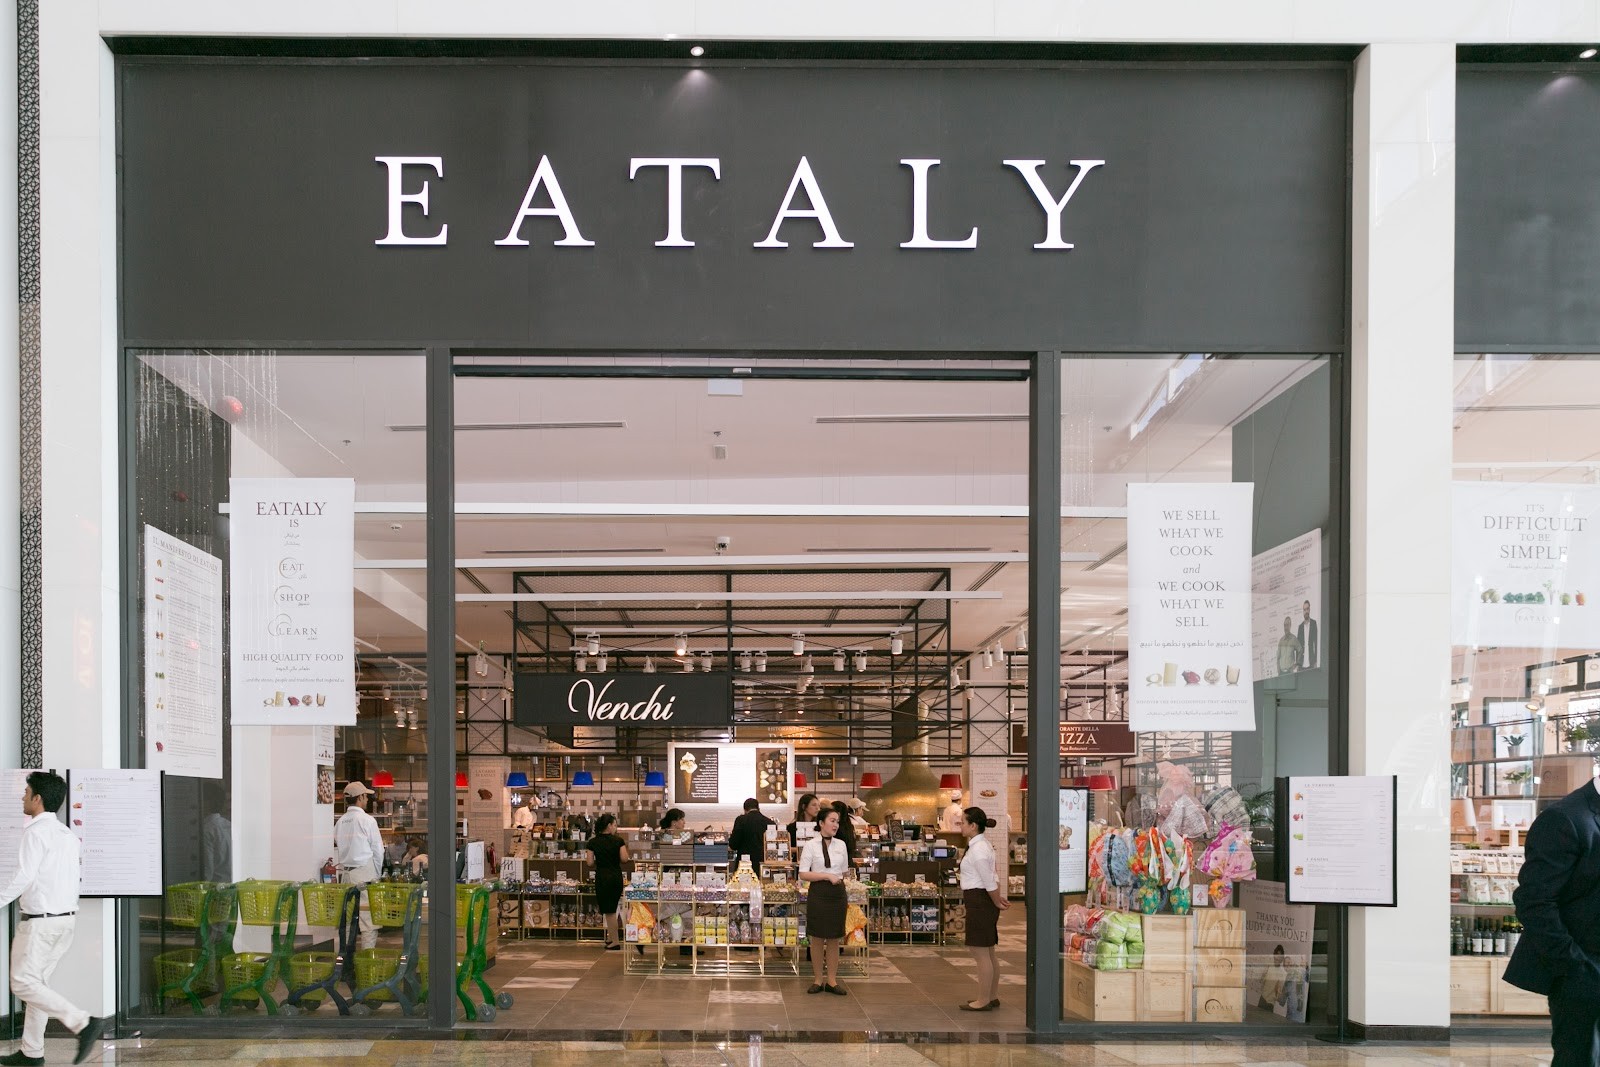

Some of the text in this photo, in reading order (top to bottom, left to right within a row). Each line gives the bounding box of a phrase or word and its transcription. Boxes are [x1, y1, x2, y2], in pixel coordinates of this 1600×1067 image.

[374, 155, 1106, 250] EATALY
[255, 501, 328, 516] EATALY
[1525, 504, 1545, 512] IT'S
[1162, 510, 1221, 521] WE SELL
[289, 519, 300, 528] IS
[1483, 515, 1587, 532] DIFFICULT
[1159, 527, 1225, 538] WHAT WE
[1519, 533, 1552, 542] TO BE
[1169, 545, 1214, 556] COOK
[1500, 545, 1568, 560] SIMPLE
[282, 563, 305, 571] EAT
[1182, 563, 1201, 574] and
[1158, 581, 1226, 592] WE COOK
[279, 593, 310, 602] SHOP
[1159, 599, 1225, 610] WHAT WE
[1175, 616, 1209, 627] SELL
[279, 627, 318, 636] LEARN
[242, 653, 344, 664] HIGH QUALITY FOOD
[567, 678, 676, 721] Venchi
[1060, 733, 1098, 745] IZZA
[1255, 911, 1295, 927] THANK YOU
[1272, 925, 1308, 943] SIMONE!
